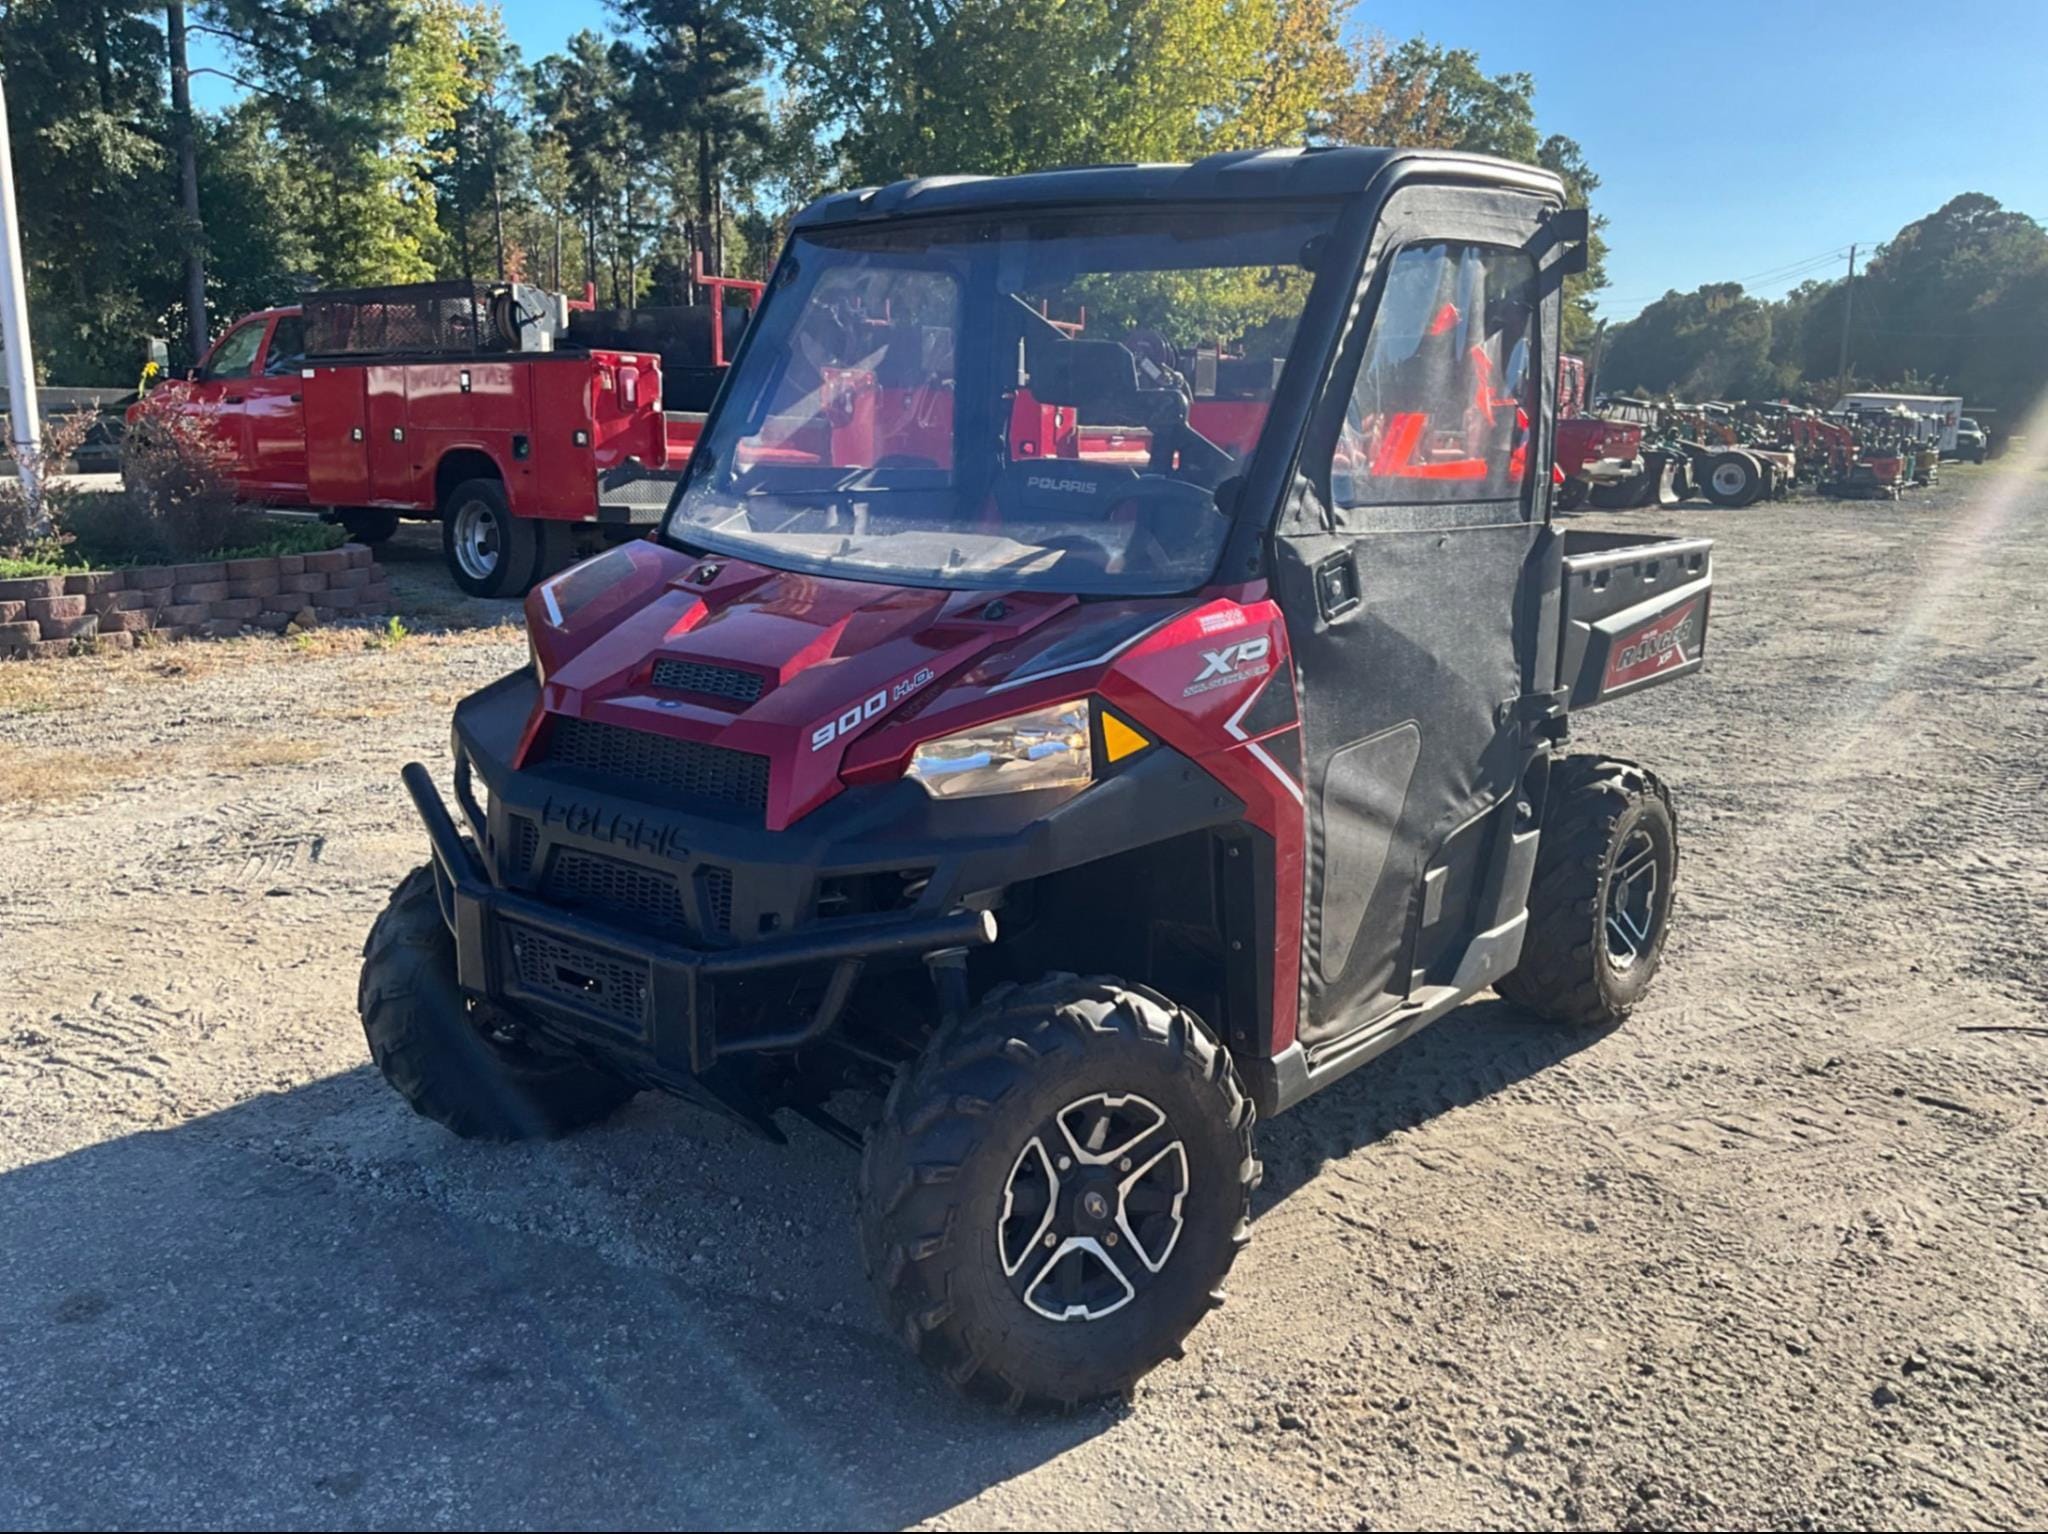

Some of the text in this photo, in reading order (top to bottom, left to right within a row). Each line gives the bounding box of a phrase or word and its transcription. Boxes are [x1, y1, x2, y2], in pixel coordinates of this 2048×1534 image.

[1027, 476, 1097, 494] POLARIS
[1193, 635, 1268, 682] XP
[811, 667, 934, 752] 900 H.O.
[542, 796, 690, 863] POLARIS
